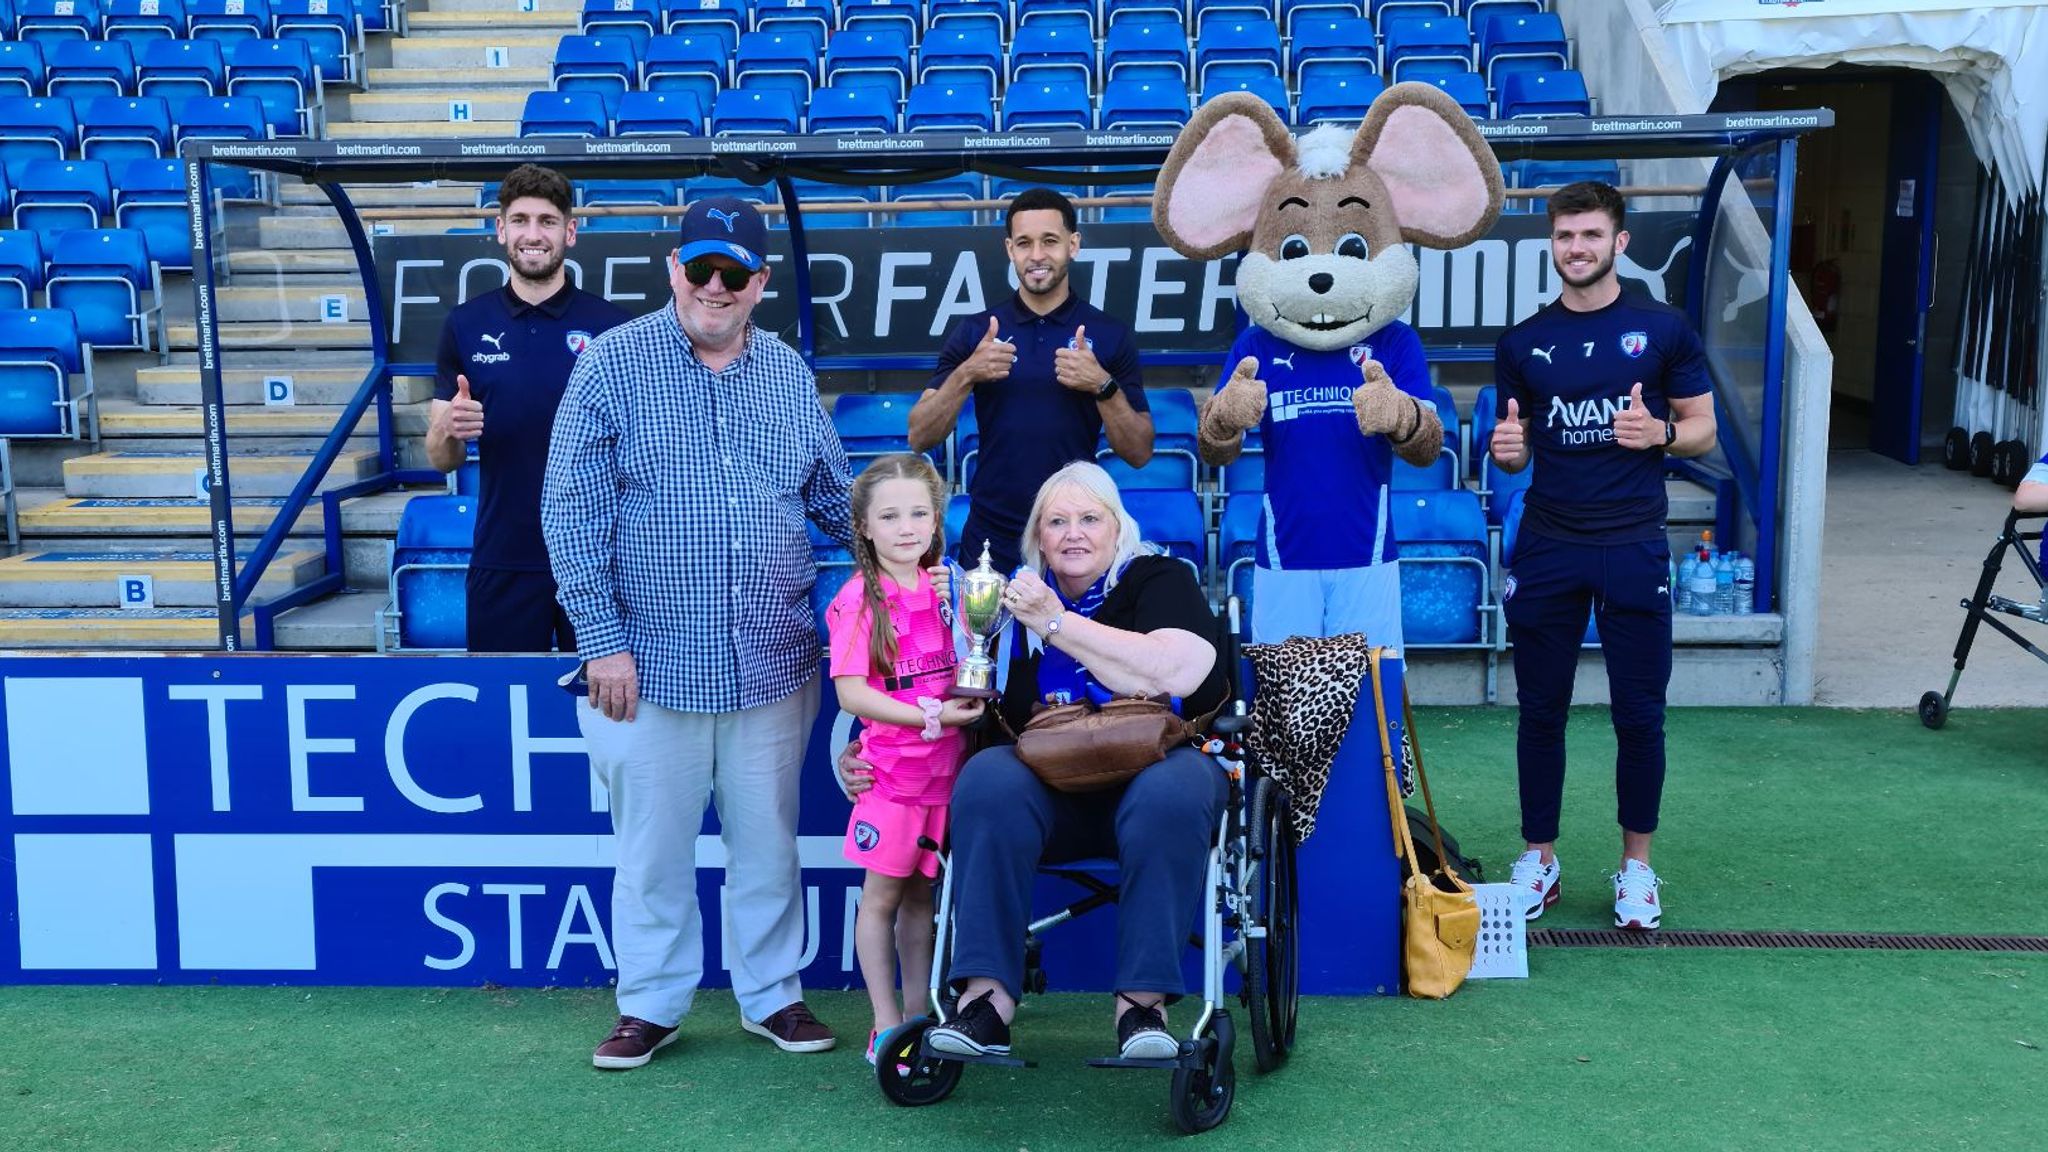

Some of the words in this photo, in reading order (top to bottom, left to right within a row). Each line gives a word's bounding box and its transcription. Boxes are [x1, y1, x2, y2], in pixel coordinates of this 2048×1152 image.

[454, 104, 468, 120] H
[1592, 119, 1682, 132] brettmartin.com
[1726, 115, 1818, 129] brettmartin.com
[1477, 124, 1548, 135] ttmartin.com
[711, 140, 797, 153] brettmartin.com
[837, 138, 924, 150] brettmartin.com
[964, 136, 1050, 148] brettmartin.com
[1086, 133, 1173, 146] brettmartin.com
[212, 145, 297, 156] brettmartin.com
[336, 144, 421, 155] brettmartin.com
[461, 143, 545, 155] brettmartin.com
[586, 142, 671, 153] brettmartin.com
[189, 163, 204, 249] brettmartin.com
[874, 247, 1255, 337] FATER
[327, 300, 342, 318] E
[200, 284, 214, 369] brettmartin.com
[1583, 342, 1595, 357] 7
[472, 352, 511, 364] citygrab
[270, 381, 288, 401] D
[1284, 386, 1356, 404] TECHNIQ
[1562, 428, 1616, 445] home
[209, 404, 222, 486] brettmartin.com
[218, 520, 231, 601] brettmartin.com
[126, 580, 146, 602] B
